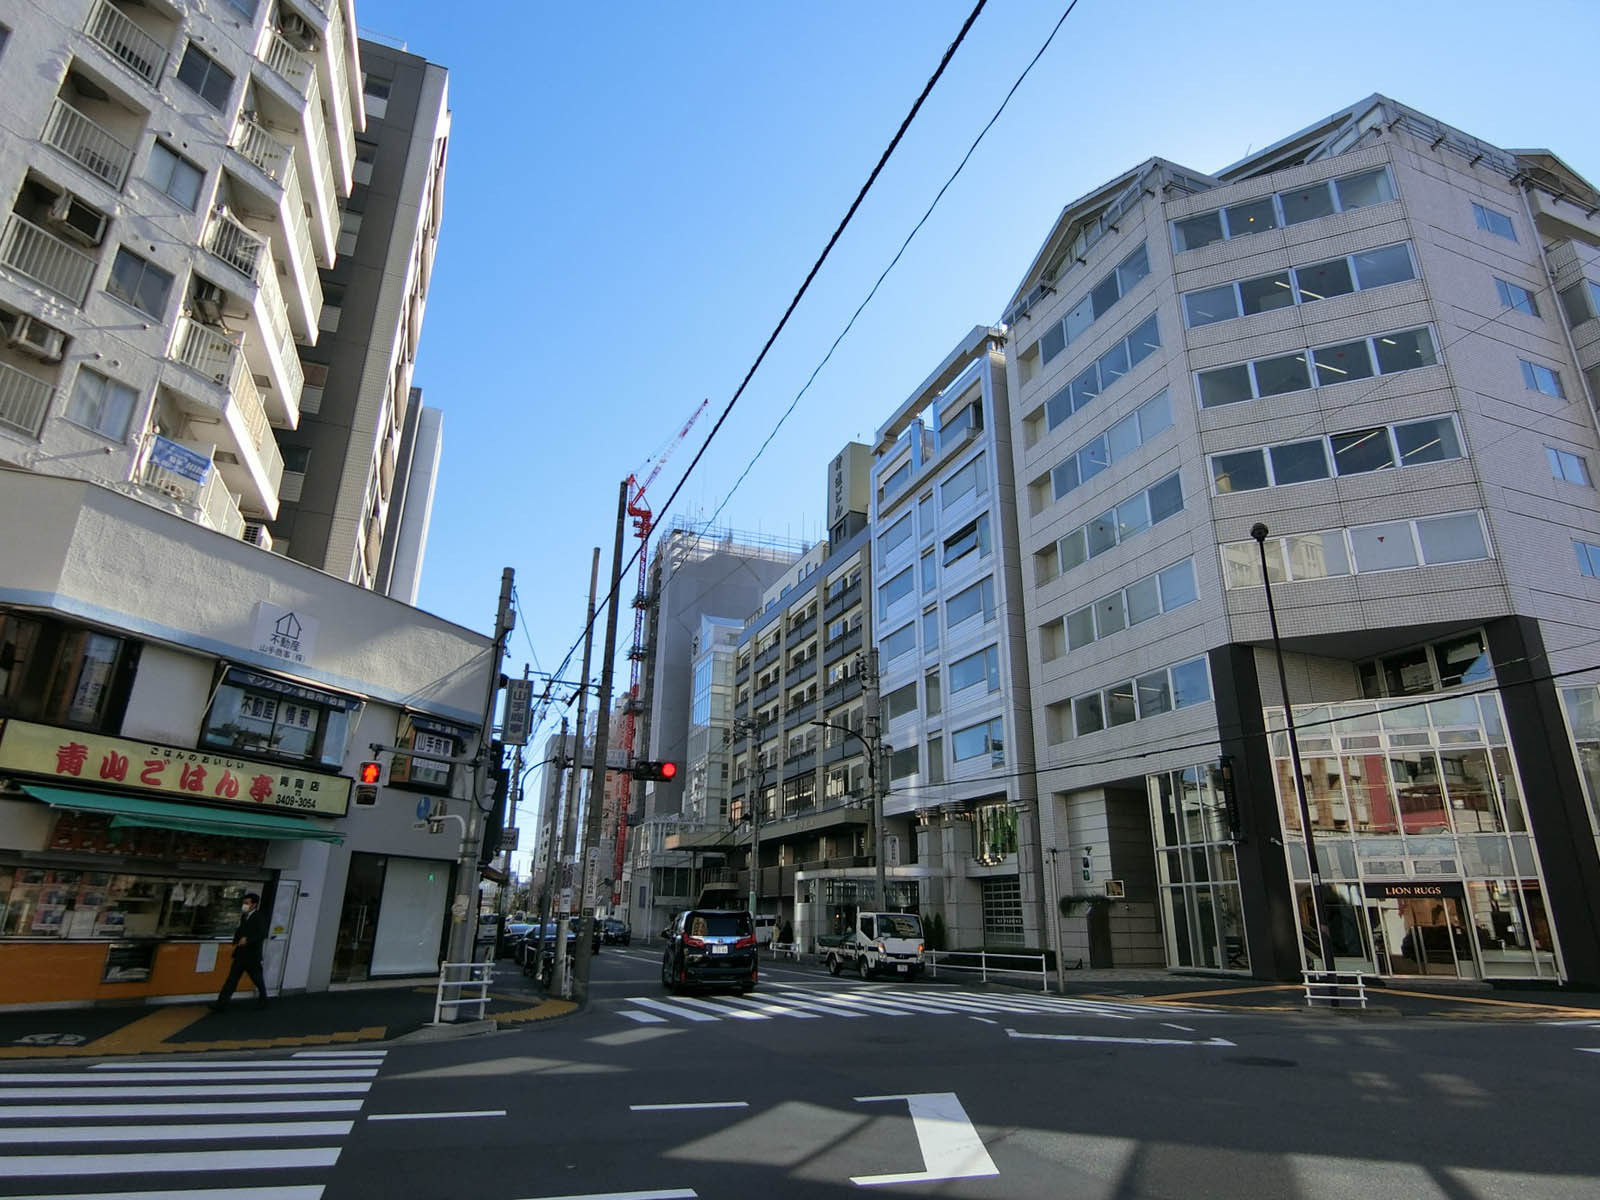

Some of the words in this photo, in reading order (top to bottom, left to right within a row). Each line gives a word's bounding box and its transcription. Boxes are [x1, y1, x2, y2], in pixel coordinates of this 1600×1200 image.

[270, 633, 301, 652] 不動産
[241, 694, 276, 720] 不動産
[416, 734, 451, 755] 山手商事
[150, 746, 245, 770] ごはんのおいしい
[55, 741, 274, 804] 青山ごはん亭
[275, 793, 317, 809] 3409-3054
[1385, 887, 1411, 895] LION
[1414, 887, 1441, 895] RUGS
